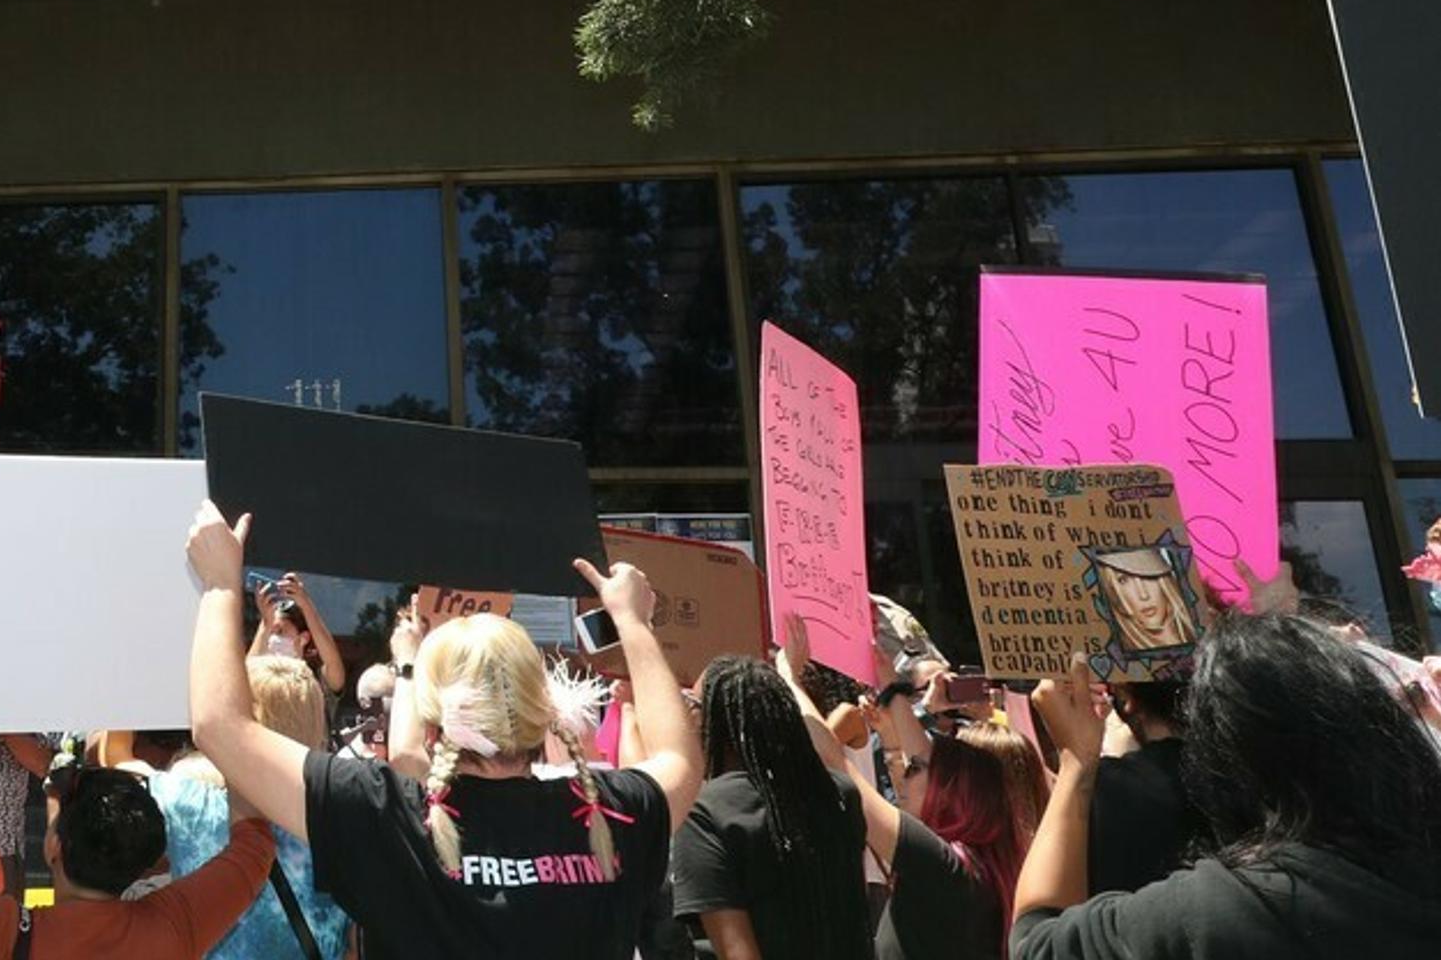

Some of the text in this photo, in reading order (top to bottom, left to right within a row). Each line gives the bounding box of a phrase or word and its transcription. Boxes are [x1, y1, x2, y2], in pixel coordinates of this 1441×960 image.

[1082, 307, 1141, 392] 4U
[768, 348, 798, 390] ALL
[988, 319, 1056, 465] itney
[957, 495, 998, 513] one
[1009, 493, 1067, 519] thing
[1088, 499, 1096, 517] i
[963, 519, 1028, 541] think
[1033, 522, 1057, 542] of
[1139, 528, 1147, 545] i
[972, 546, 1065, 570] think of
[977, 577, 1083, 602] britney is
[982, 605, 1088, 626] dementia
[988, 632, 1103, 657] britney is
[448, 855, 622, 886] FREEBRITN
